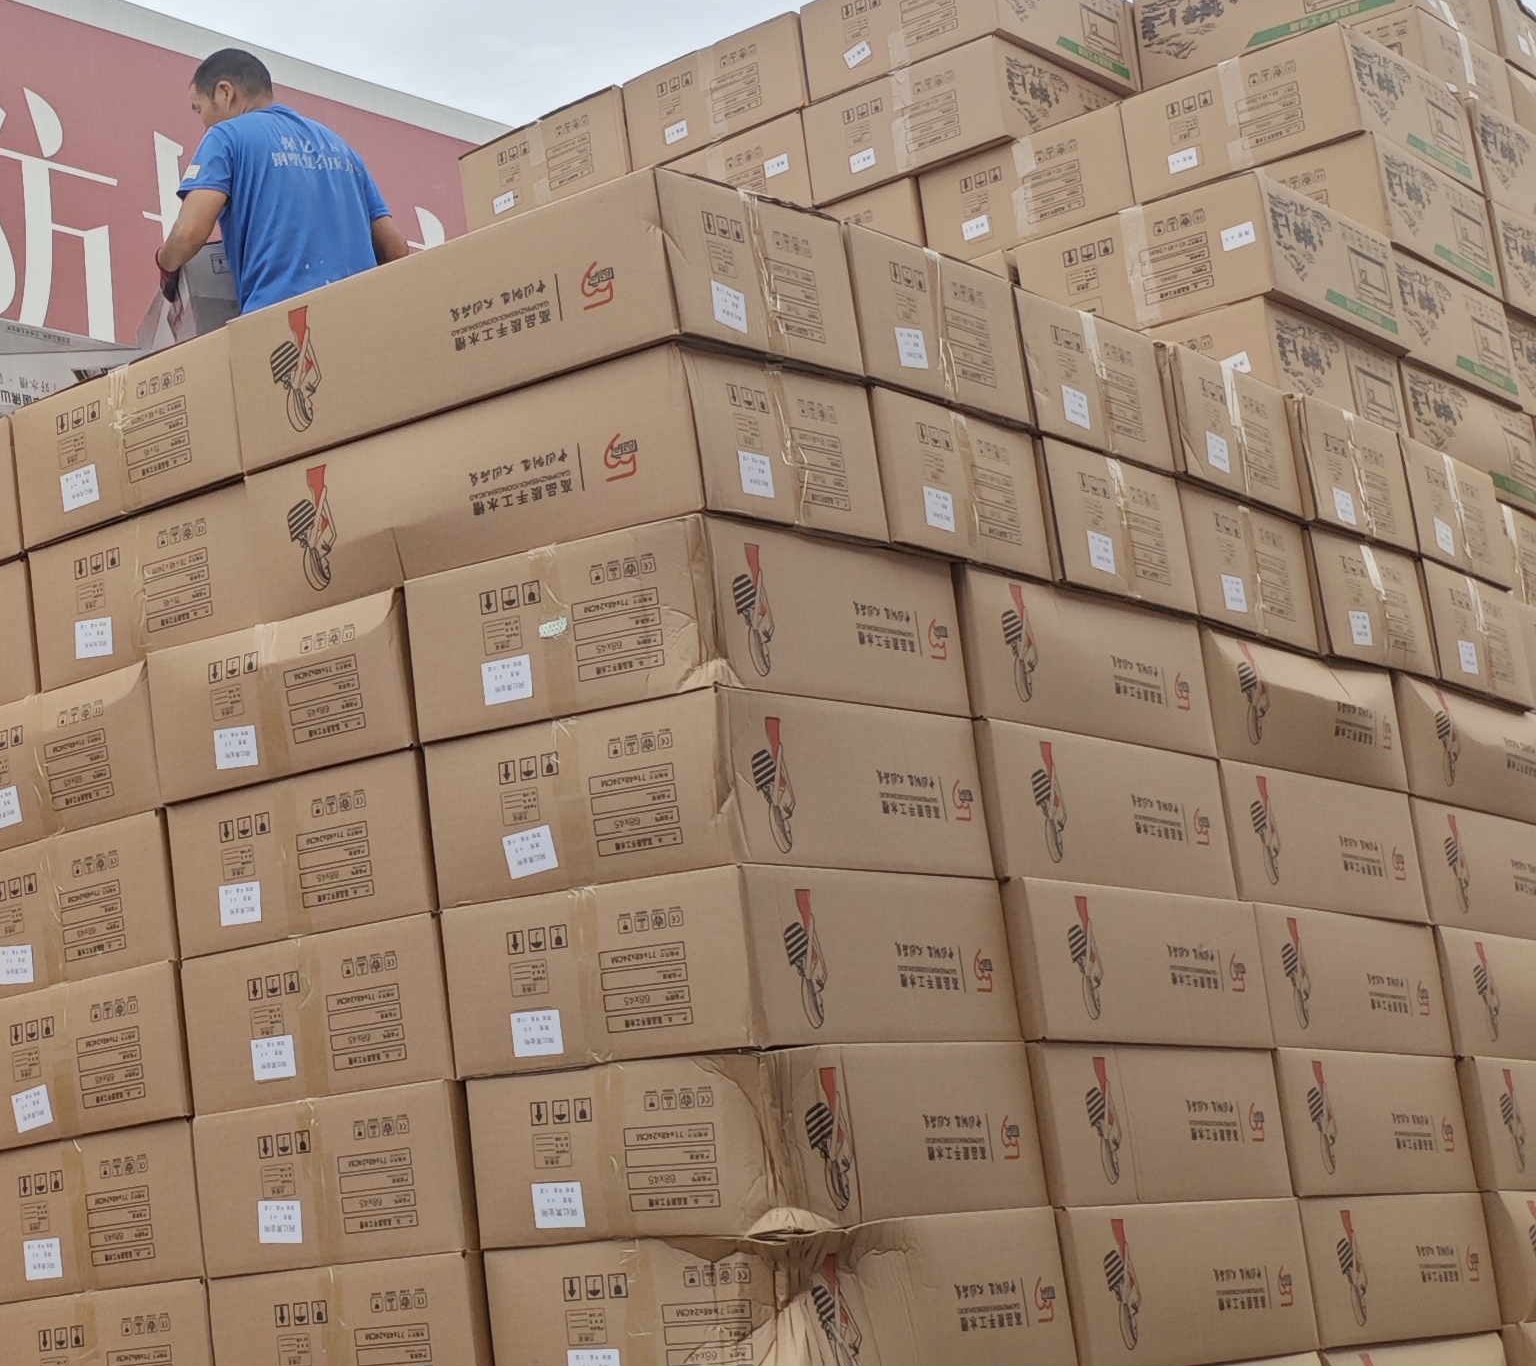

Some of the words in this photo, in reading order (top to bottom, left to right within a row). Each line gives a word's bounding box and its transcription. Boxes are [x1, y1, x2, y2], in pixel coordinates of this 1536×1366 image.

[453, 309, 551, 351] 高品质手工水槽
[472, 478, 573, 516] 高品质手工水槽
[596, 640, 622, 653] 68x45
[614, 817, 640, 828] 68x45
[623, 995, 651, 1006] 68x45
[648, 1174, 676, 1184] 68x45
[689, 1350, 718, 1362] 68x45
